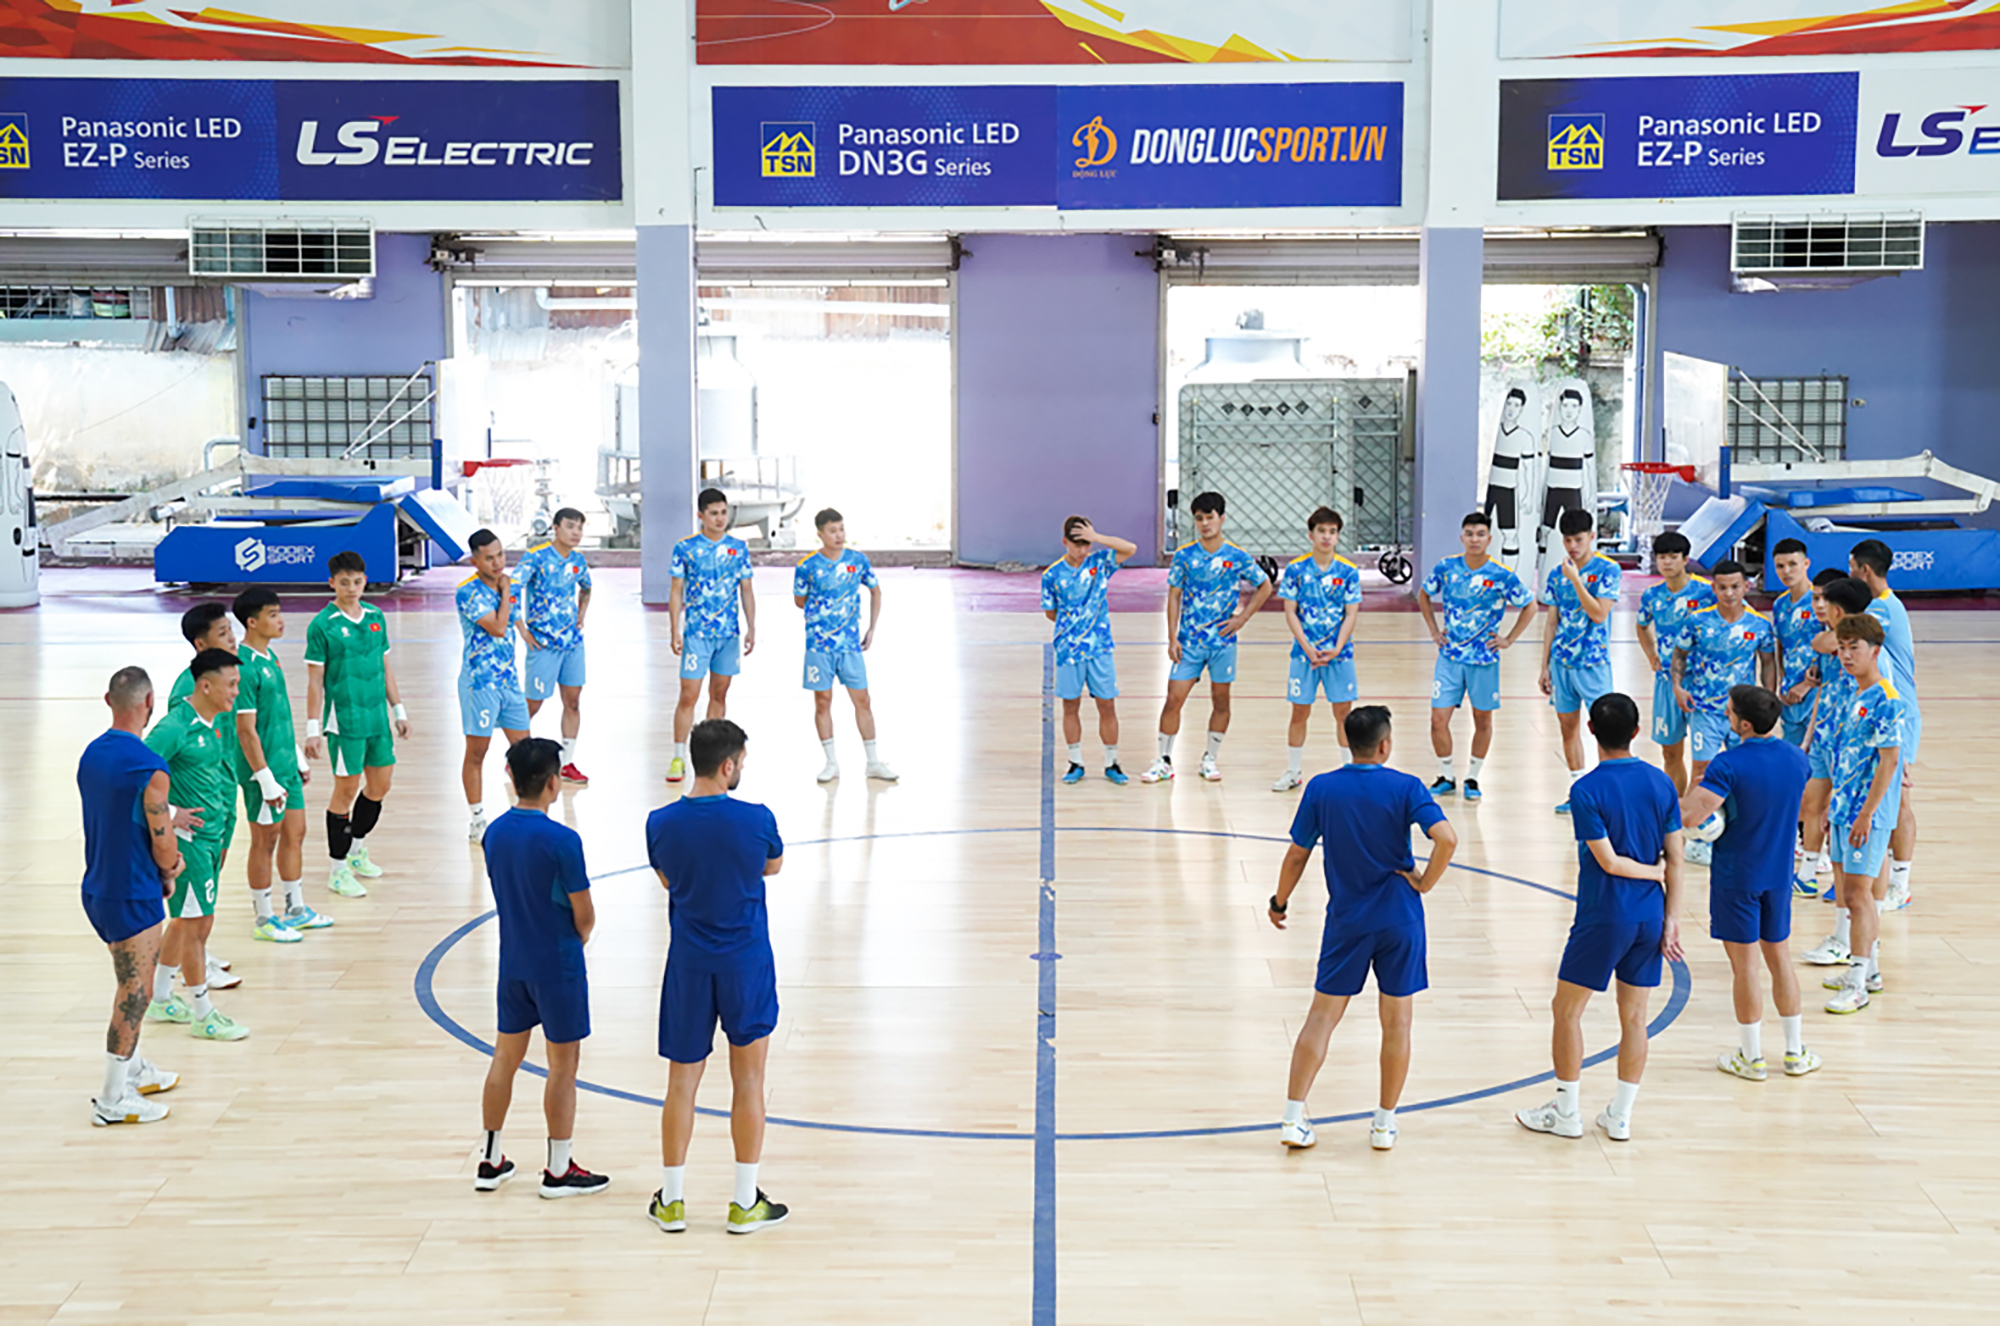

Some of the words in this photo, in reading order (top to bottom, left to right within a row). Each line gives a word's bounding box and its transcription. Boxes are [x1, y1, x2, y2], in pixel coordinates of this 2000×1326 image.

[62, 116, 188, 138] Panasonic
[195, 117, 242, 138] LED
[839, 122, 965, 145] Panasonic
[973, 122, 1020, 144] LED
[1638, 112, 1766, 137] Panasonic
[1773, 111, 1822, 134] LED
[1876, 111, 1967, 157] LS
[296, 121, 380, 165] LS
[384, 137, 594, 165] ELECTRIC
[1130, 126, 1388, 164] DONGLUCSPORT.VN
[1637, 141, 1703, 167] EZ-P
[1708, 147, 1766, 167] Series
[63, 142, 128, 168] EZ-P
[133, 150, 190, 169] Series
[765, 155, 812, 173] TSN
[839, 150, 928, 176] DN3G
[935, 157, 992, 176] Series
[1551, 147, 1601, 165] TSN
[266, 554, 316, 565] SPORT
[534, 676, 545, 694] 4
[1693, 731, 1704, 751] 9
